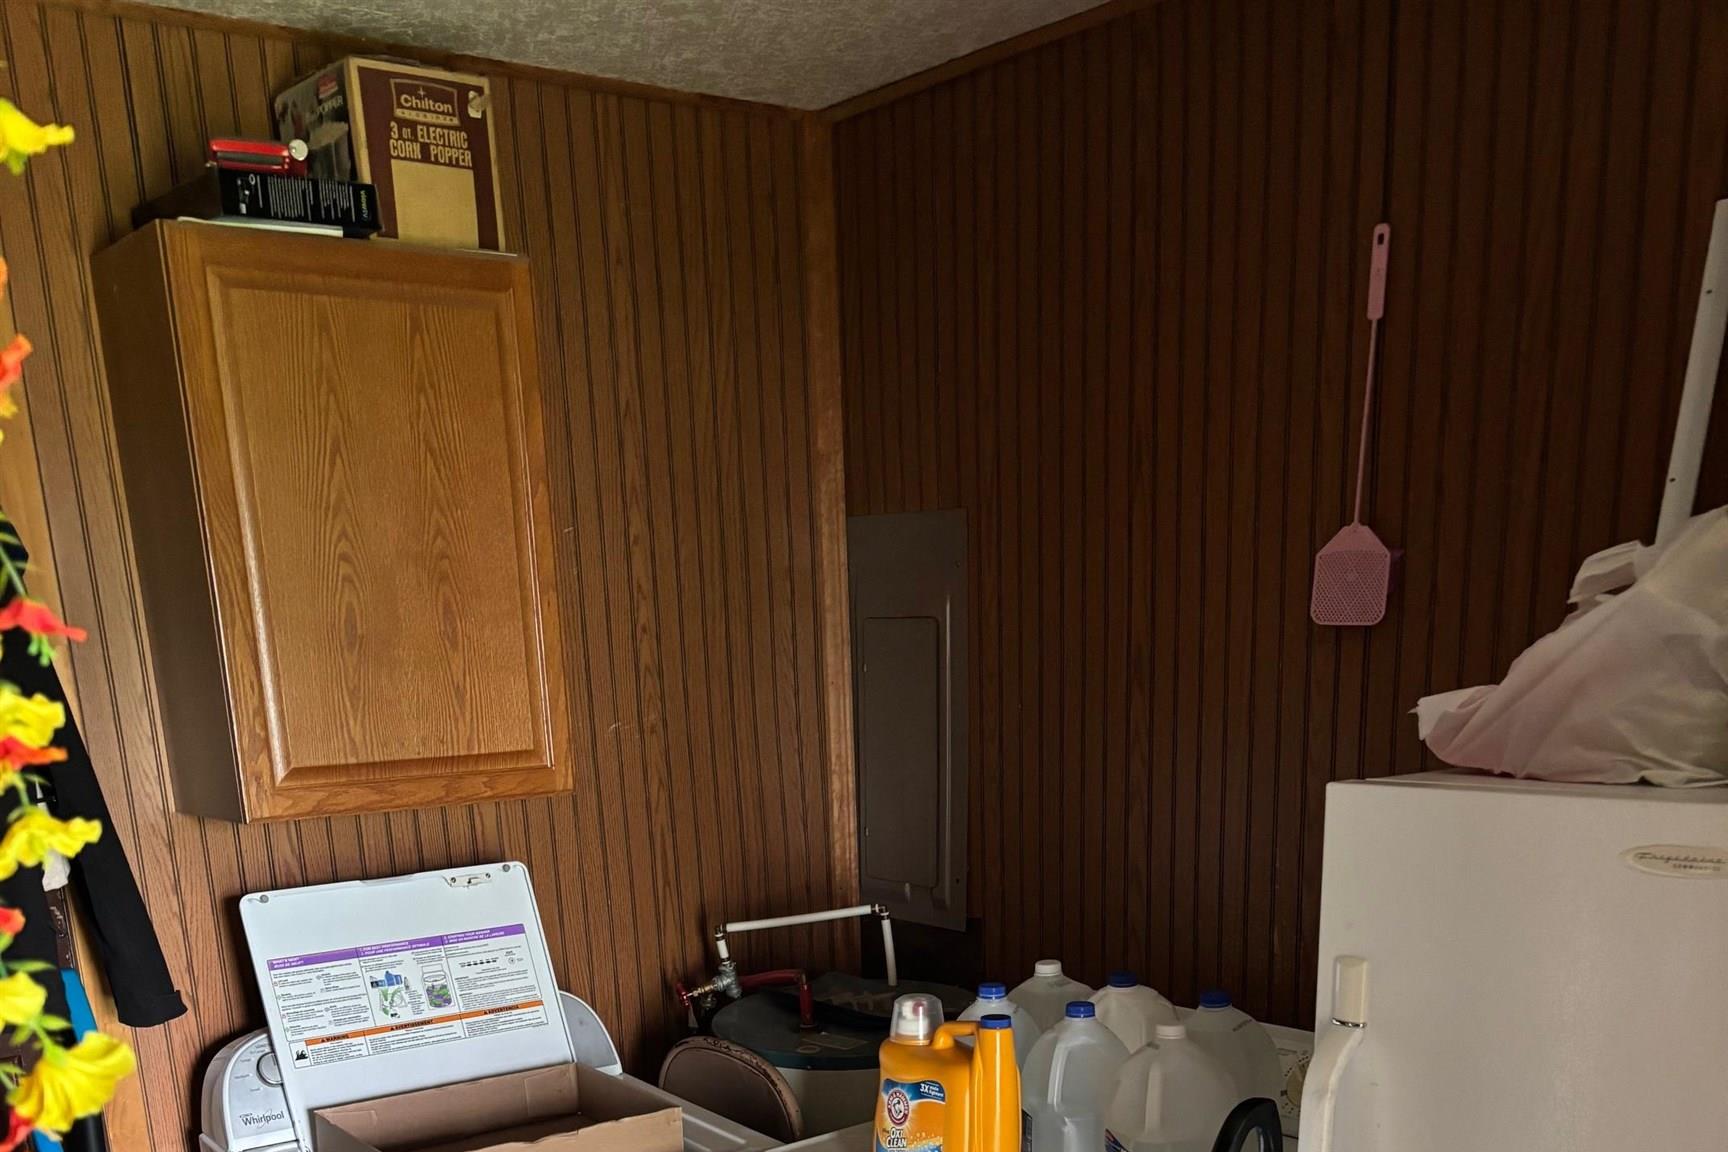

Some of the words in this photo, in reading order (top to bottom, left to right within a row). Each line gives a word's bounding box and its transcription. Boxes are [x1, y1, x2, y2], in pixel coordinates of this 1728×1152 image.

[400, 94, 453, 113] Chilton
[389, 121, 399, 139] 3
[417, 124, 468, 149] ELECTRIC
[390, 139, 421, 159] CORN
[430, 145, 472, 168] POPPER
[241, 1111, 285, 1127] Whirlpool
[886, 1136, 907, 1149] CLEAN
